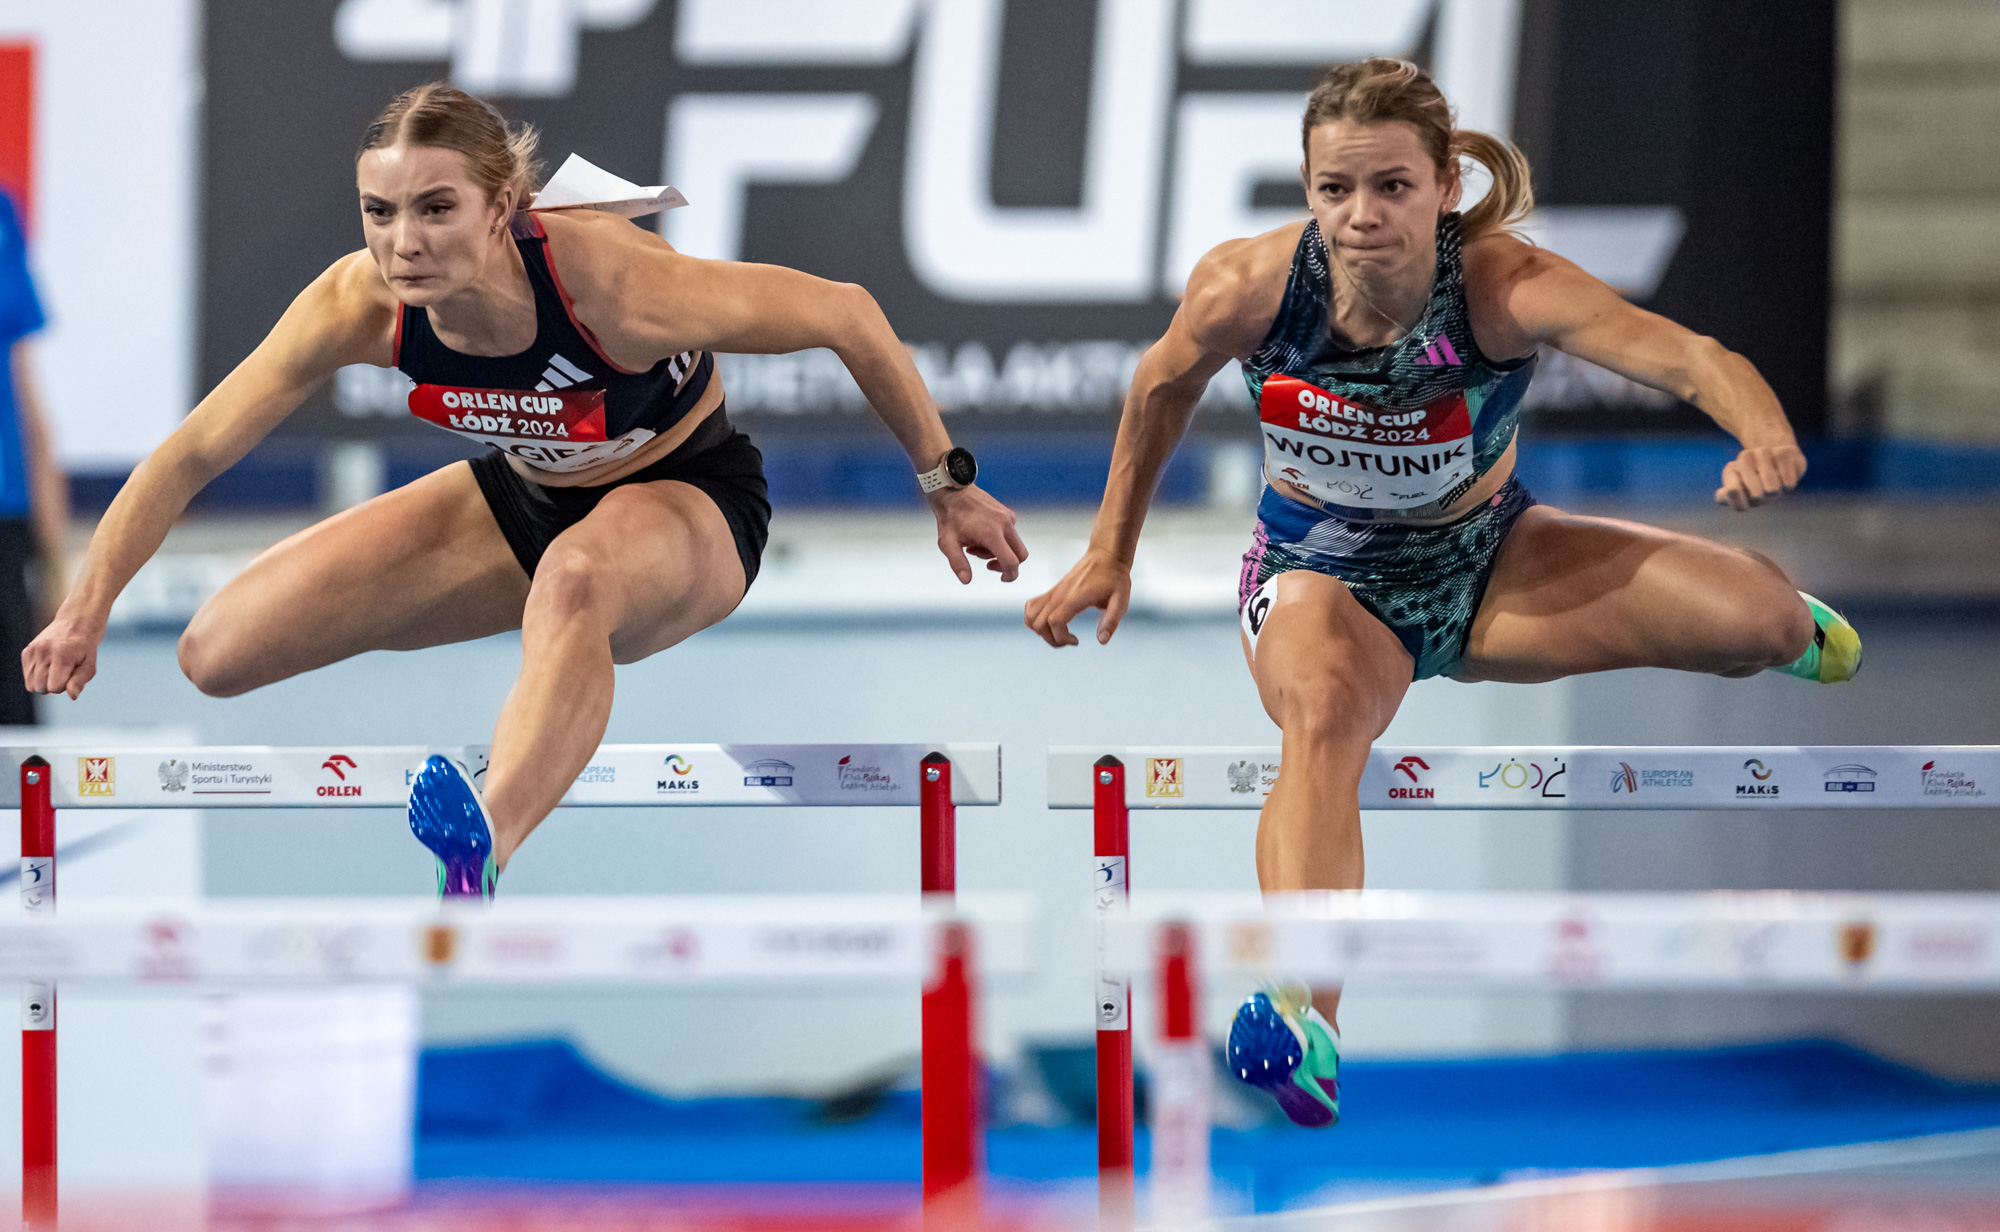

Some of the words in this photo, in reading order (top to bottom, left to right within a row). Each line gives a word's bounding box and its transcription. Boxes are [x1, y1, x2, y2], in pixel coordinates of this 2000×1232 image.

[442, 391, 517, 411] ORLEN
[520, 395, 564, 415] CUP
[1298, 389, 1375, 425] ORLEN
[1378, 409, 1427, 427] CUP
[448, 410, 515, 433] ŁÓDŹ
[517, 419, 569, 437] 2024
[1298, 412, 1368, 439] ŁÓDŹ
[1373, 427, 1430, 442] 2024
[1267, 432, 1467, 477] WOJTUNIK
[1248, 587, 1270, 636] 6
[192, 763, 253, 772] Ministerstwo
[1641, 770, 1694, 779] EUROPEAN
[192, 774, 222, 784] Sportu
[230, 774, 272, 785] Turystyki
[1641, 778, 1693, 787] ATHLETICS
[317, 786, 362, 797] ORLEN
[1388, 788, 1434, 799] ORLEN
